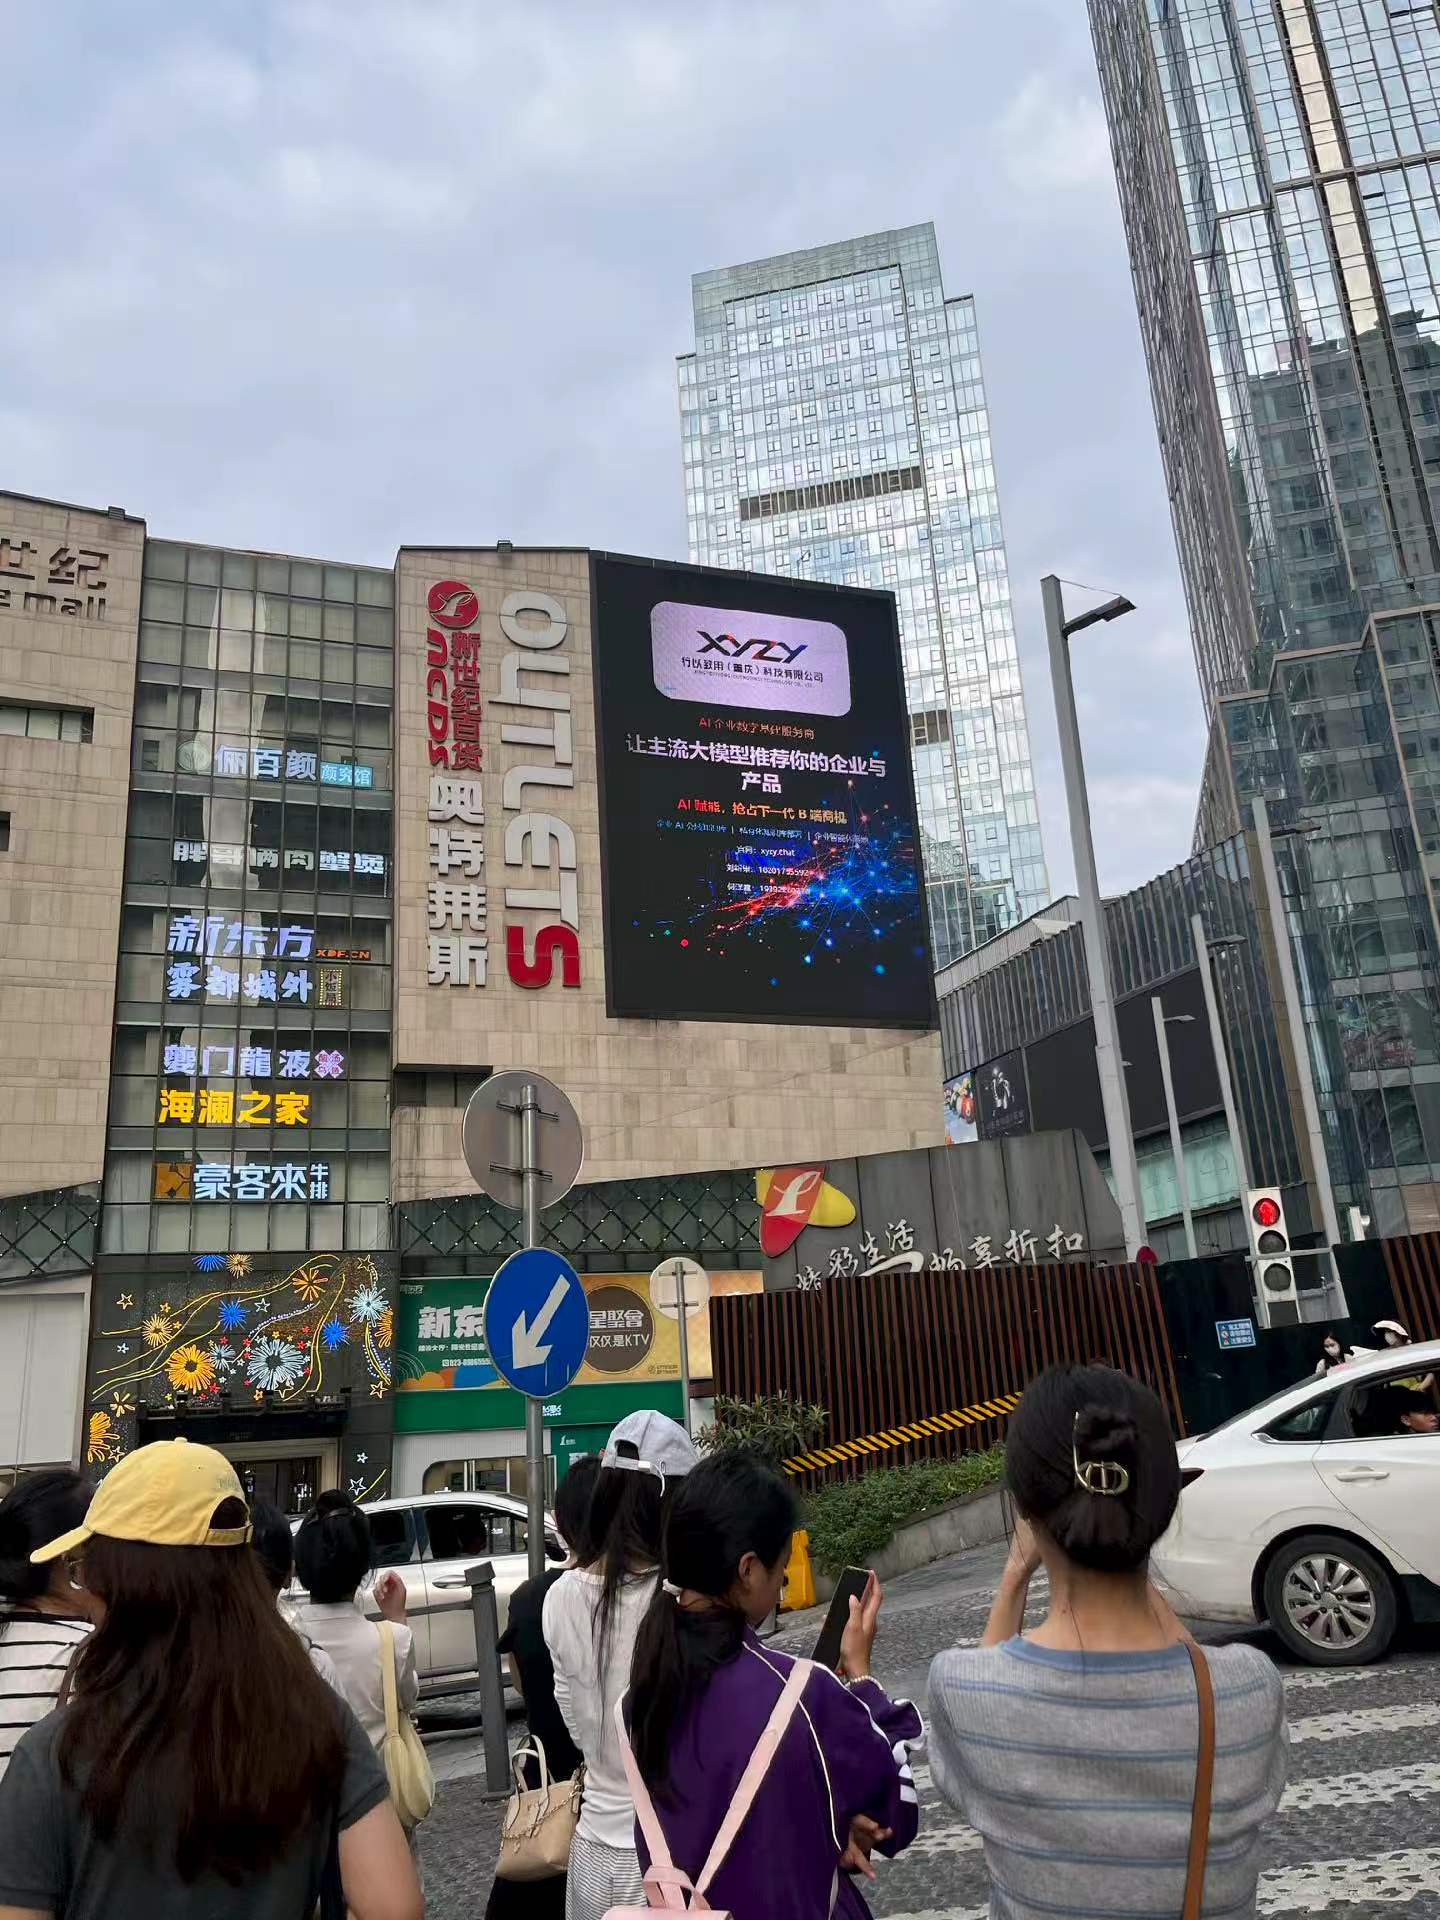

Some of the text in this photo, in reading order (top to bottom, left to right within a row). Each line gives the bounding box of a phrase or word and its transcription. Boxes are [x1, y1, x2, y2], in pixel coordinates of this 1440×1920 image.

[24, 591, 106, 618] mall
[450, 630, 482, 773] 新世纪百货
[626, 733, 886, 778] 让主流大模型推荐你的企业与
[741, 771, 782, 794] 产品
[677, 799, 691, 810] AI
[427, 775, 489, 987] 奥特莱斯
[167, 915, 315, 965] 新东方
[167, 961, 314, 1004] 雾都城外
[159, 1089, 310, 1126] 海澜之家
[194, 1162, 308, 1200] 豪客來
[310, 1163, 329, 1200] 牛排
